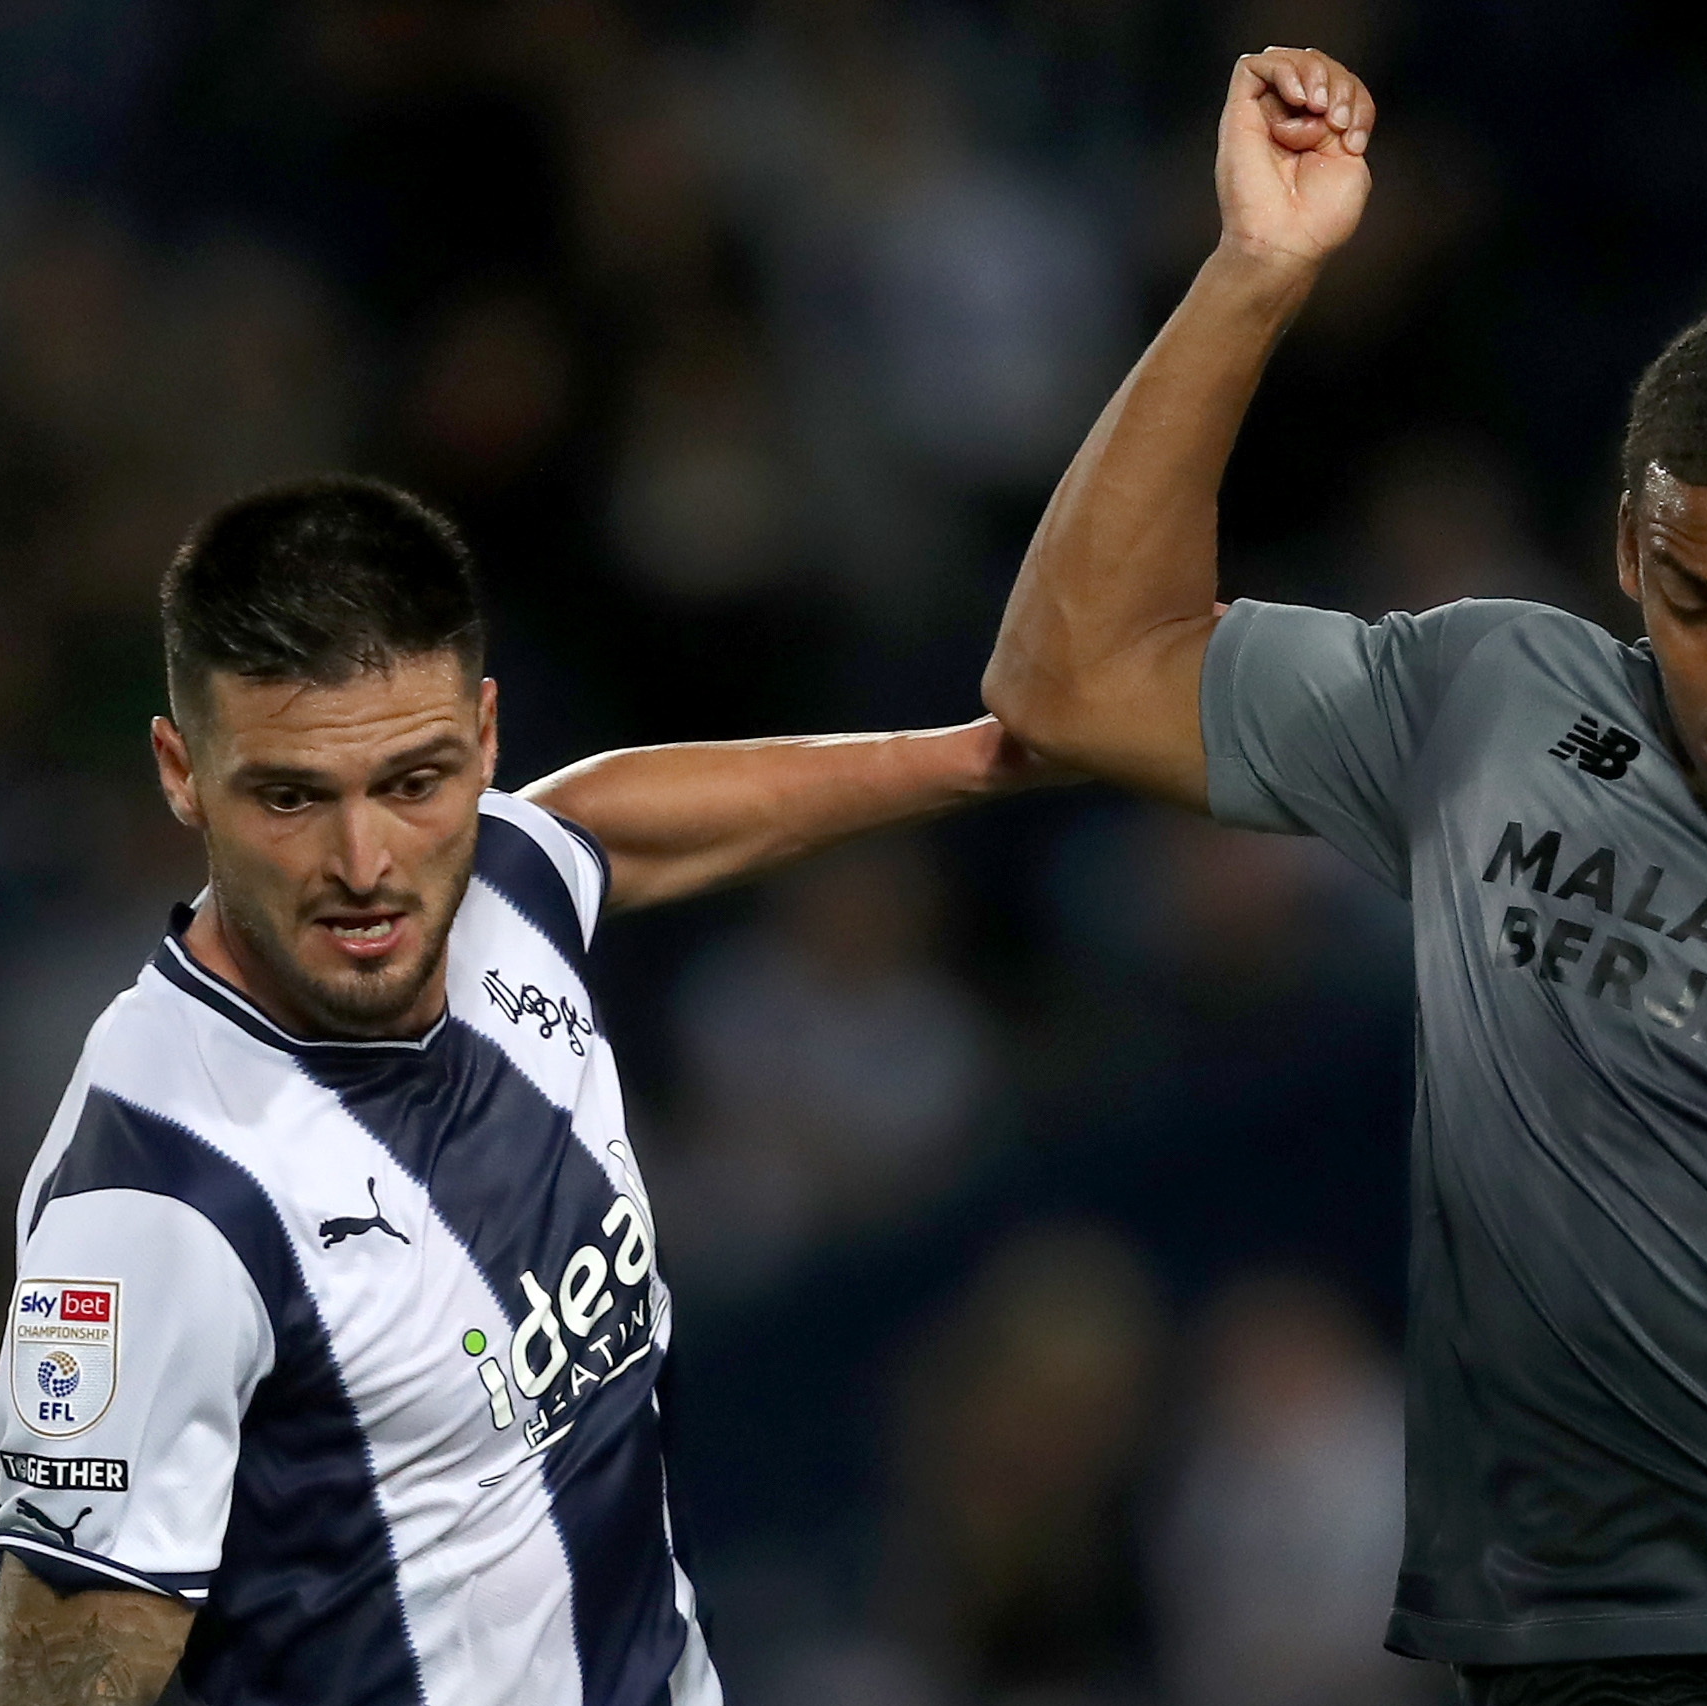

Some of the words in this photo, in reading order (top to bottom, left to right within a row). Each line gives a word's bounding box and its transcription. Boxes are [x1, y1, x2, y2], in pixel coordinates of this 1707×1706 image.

[20, 1291, 57, 1318] sky
[65, 1293, 105, 1315] bet
[17, 1325, 109, 1340] CHAMPIONSHIP
[39, 1401, 75, 1421] EFL
